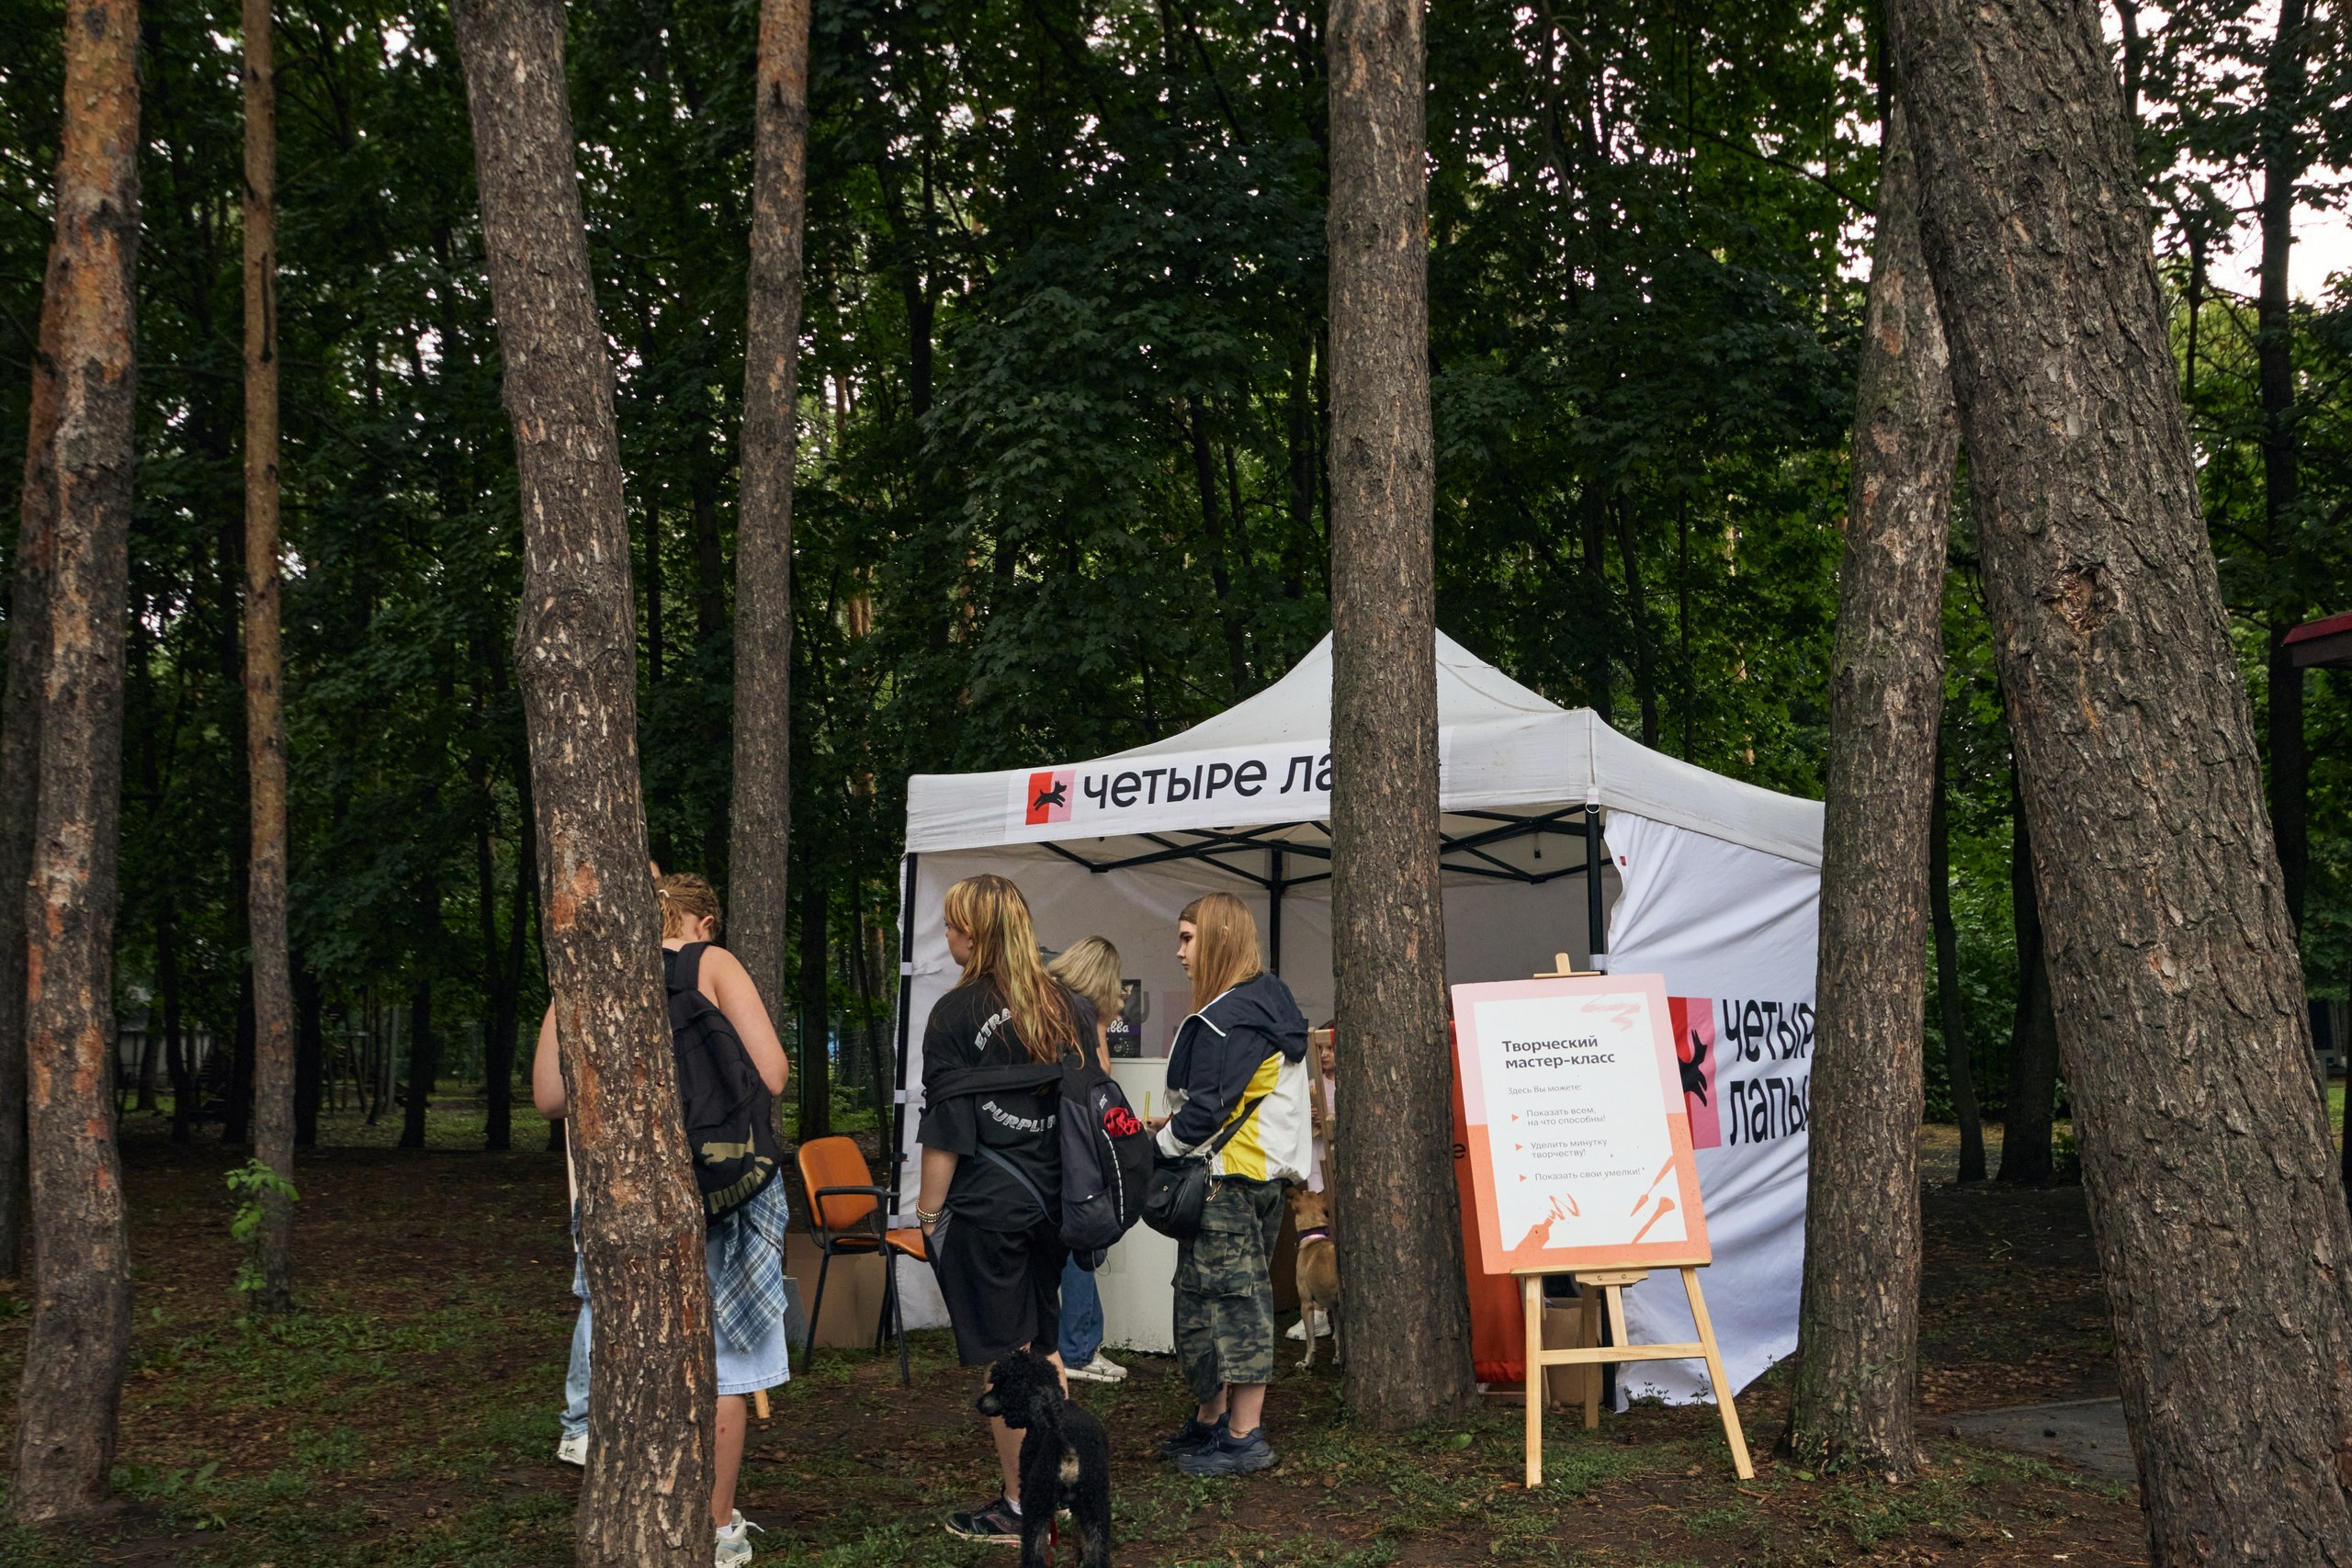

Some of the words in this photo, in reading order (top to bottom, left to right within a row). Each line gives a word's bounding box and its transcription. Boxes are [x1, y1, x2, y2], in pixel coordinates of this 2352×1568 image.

[1083, 760, 1267, 809] четыре
[1280, 752, 1331, 795] ла
[1722, 998, 1815, 1063] четыр
[1501, 1035, 1599, 1054] Творческий
[1505, 1054, 1616, 1069] мастер-класс
[1508, 1087, 1532, 1095] Здесь
[1533, 1085, 1546, 1093] Вы
[1547, 1084, 1582, 1092] можете:
[1526, 1109, 1569, 1118] Показать
[1571, 1107, 1597, 1115] всем,
[1730, 1075, 1809, 1146] лапы
[1558, 1114, 1606, 1125] способны!
[1531, 1142, 1568, 1150] Уделить
[1570, 1138, 1608, 1147] минутку
[1532, 1148, 1587, 1159] творчеству!
[1535, 1171, 1577, 1181] Показать
[1579, 1170, 1602, 1179] свои
